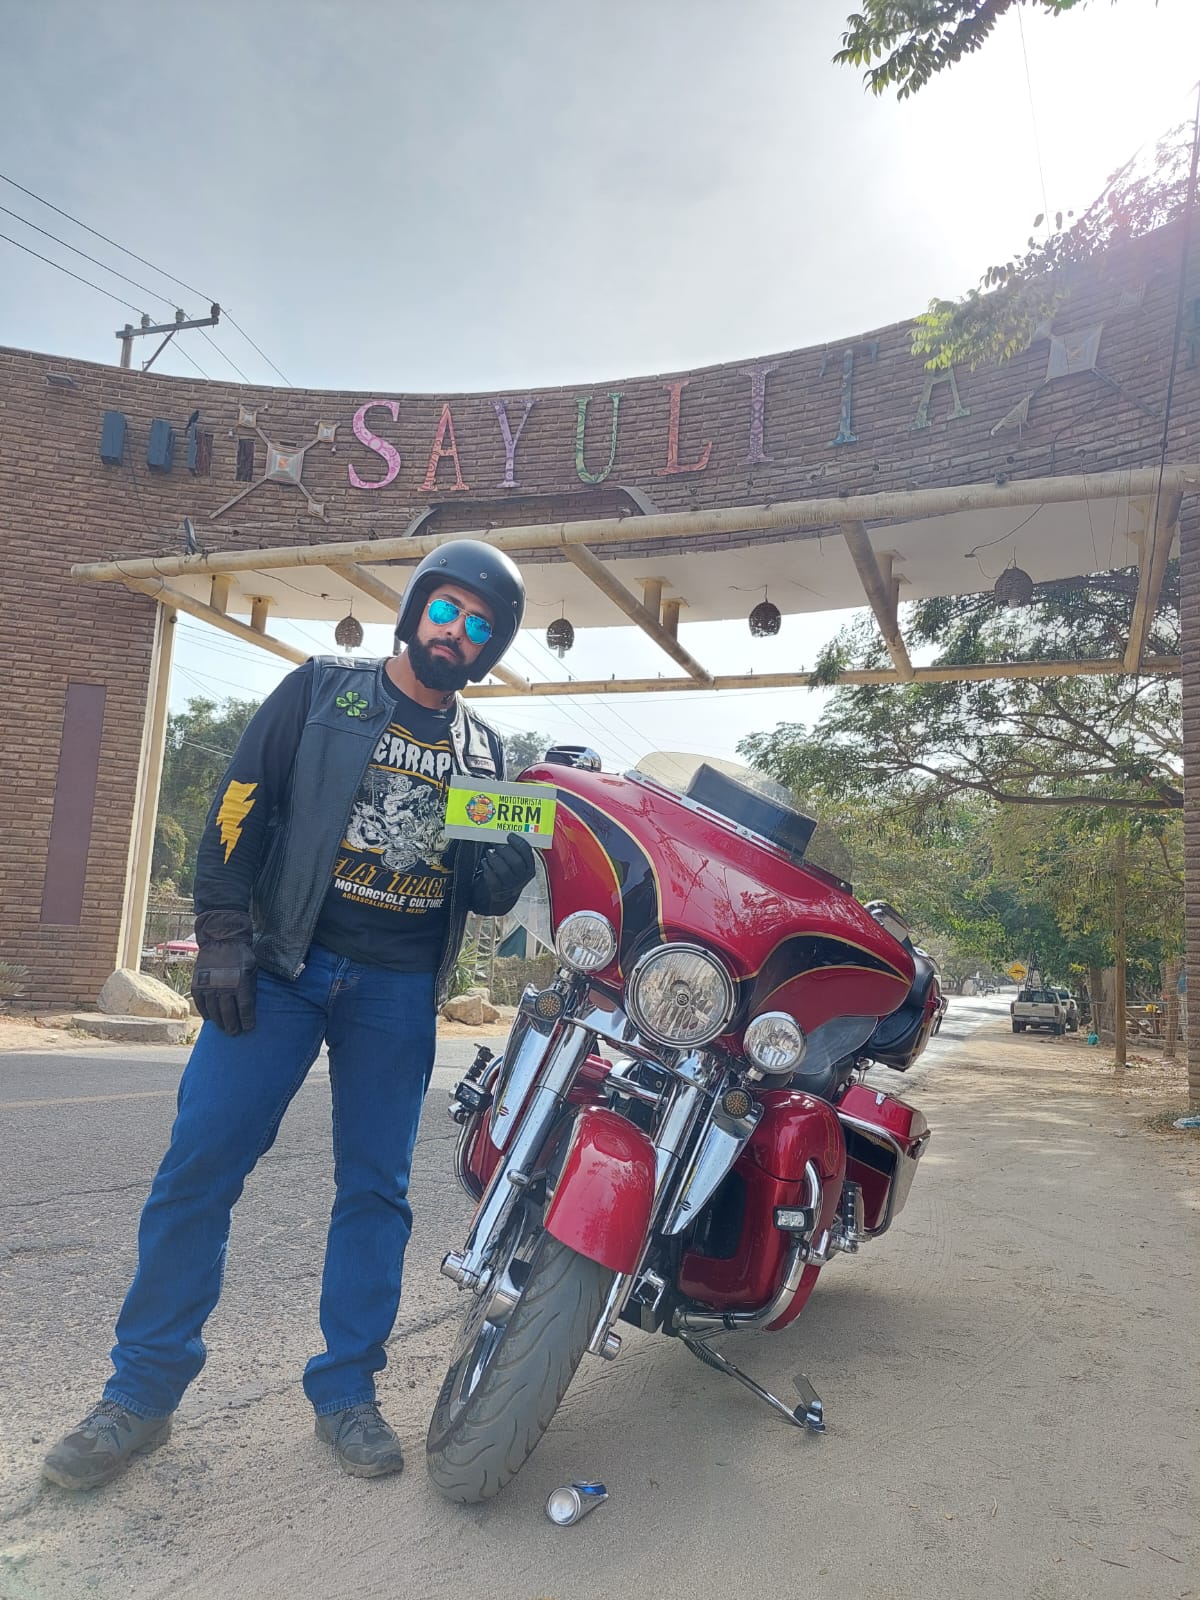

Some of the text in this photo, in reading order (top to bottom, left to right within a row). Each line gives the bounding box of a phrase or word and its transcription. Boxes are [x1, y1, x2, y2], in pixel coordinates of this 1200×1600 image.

[348, 336, 971, 491] SAYULITA
[499, 795, 542, 806] MOTOTURISTA
[497, 803, 542, 824] RRM
[496, 821, 523, 833] MÉXICO
[334, 878, 444, 908] MOTORCYCLE CULTURE
